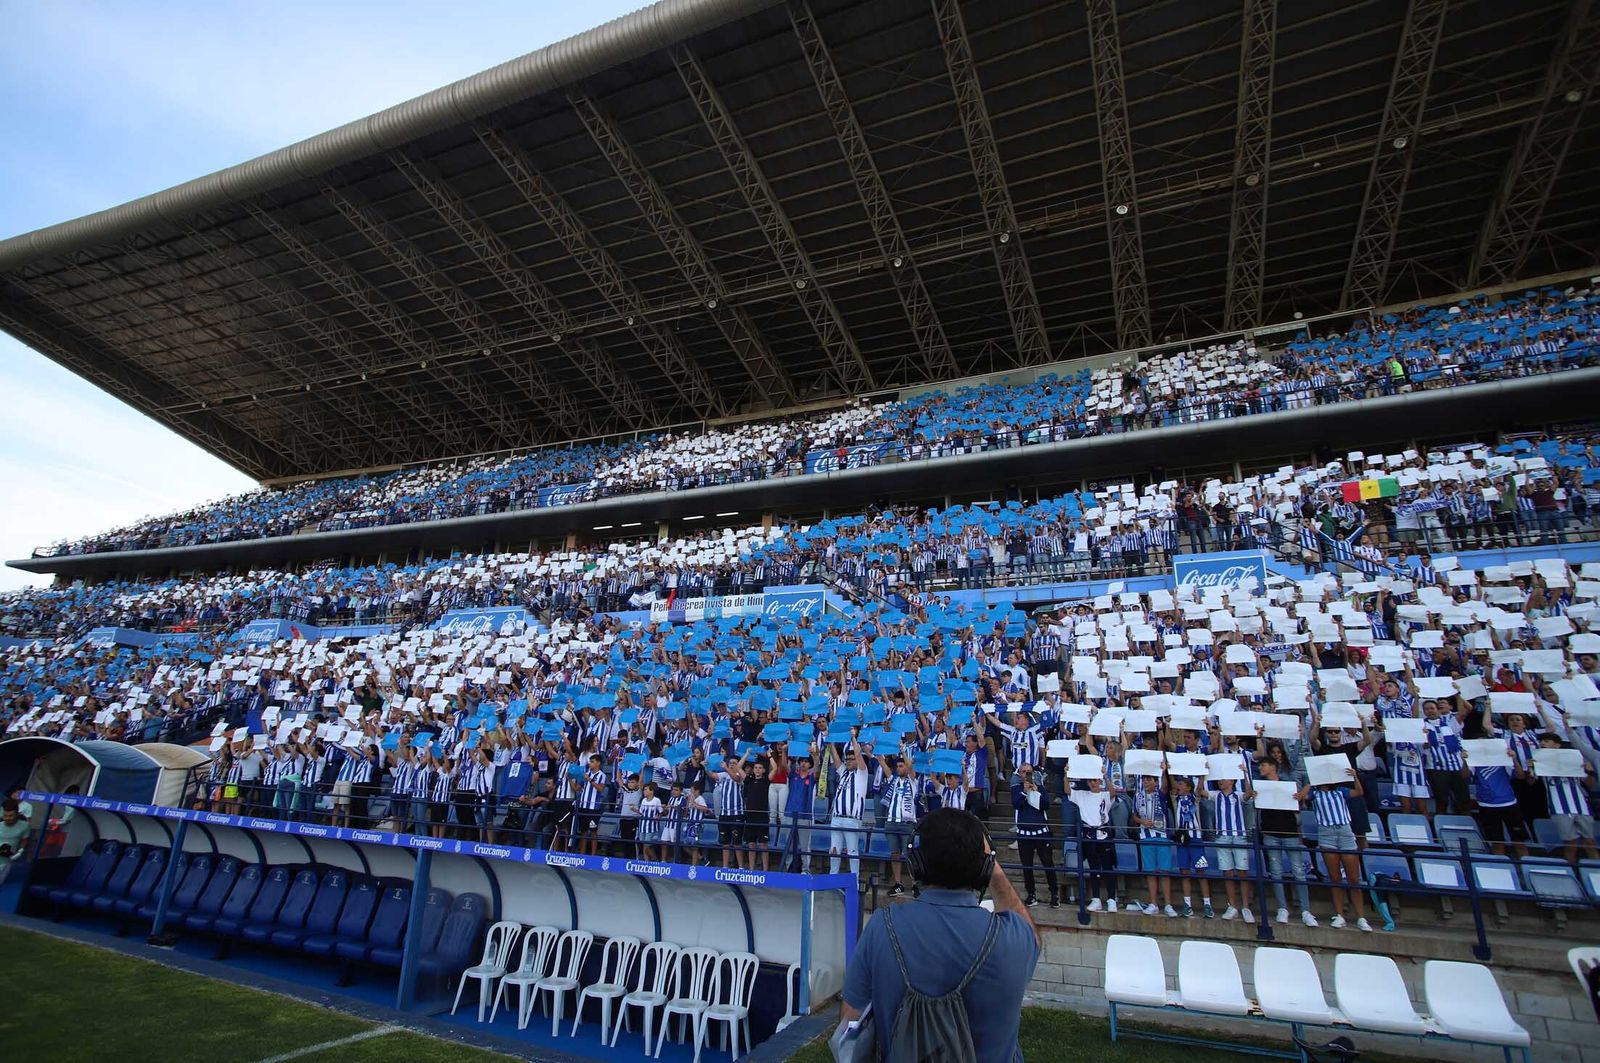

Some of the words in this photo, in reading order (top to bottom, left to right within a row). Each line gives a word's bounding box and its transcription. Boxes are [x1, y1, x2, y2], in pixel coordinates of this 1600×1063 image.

[674, 598, 732, 610] Recreativista
[734, 597, 745, 607] de
[299, 824, 327, 836] Cruzcampo
[352, 830, 383, 842] Cruzcampo
[409, 836, 443, 850] Cruzcampo
[473, 843, 511, 858] Cruzcampo
[545, 852, 586, 867] Cruzcampo
[626, 860, 671, 877] Cruzcampo
[715, 869, 766, 885] Cruzcampo
